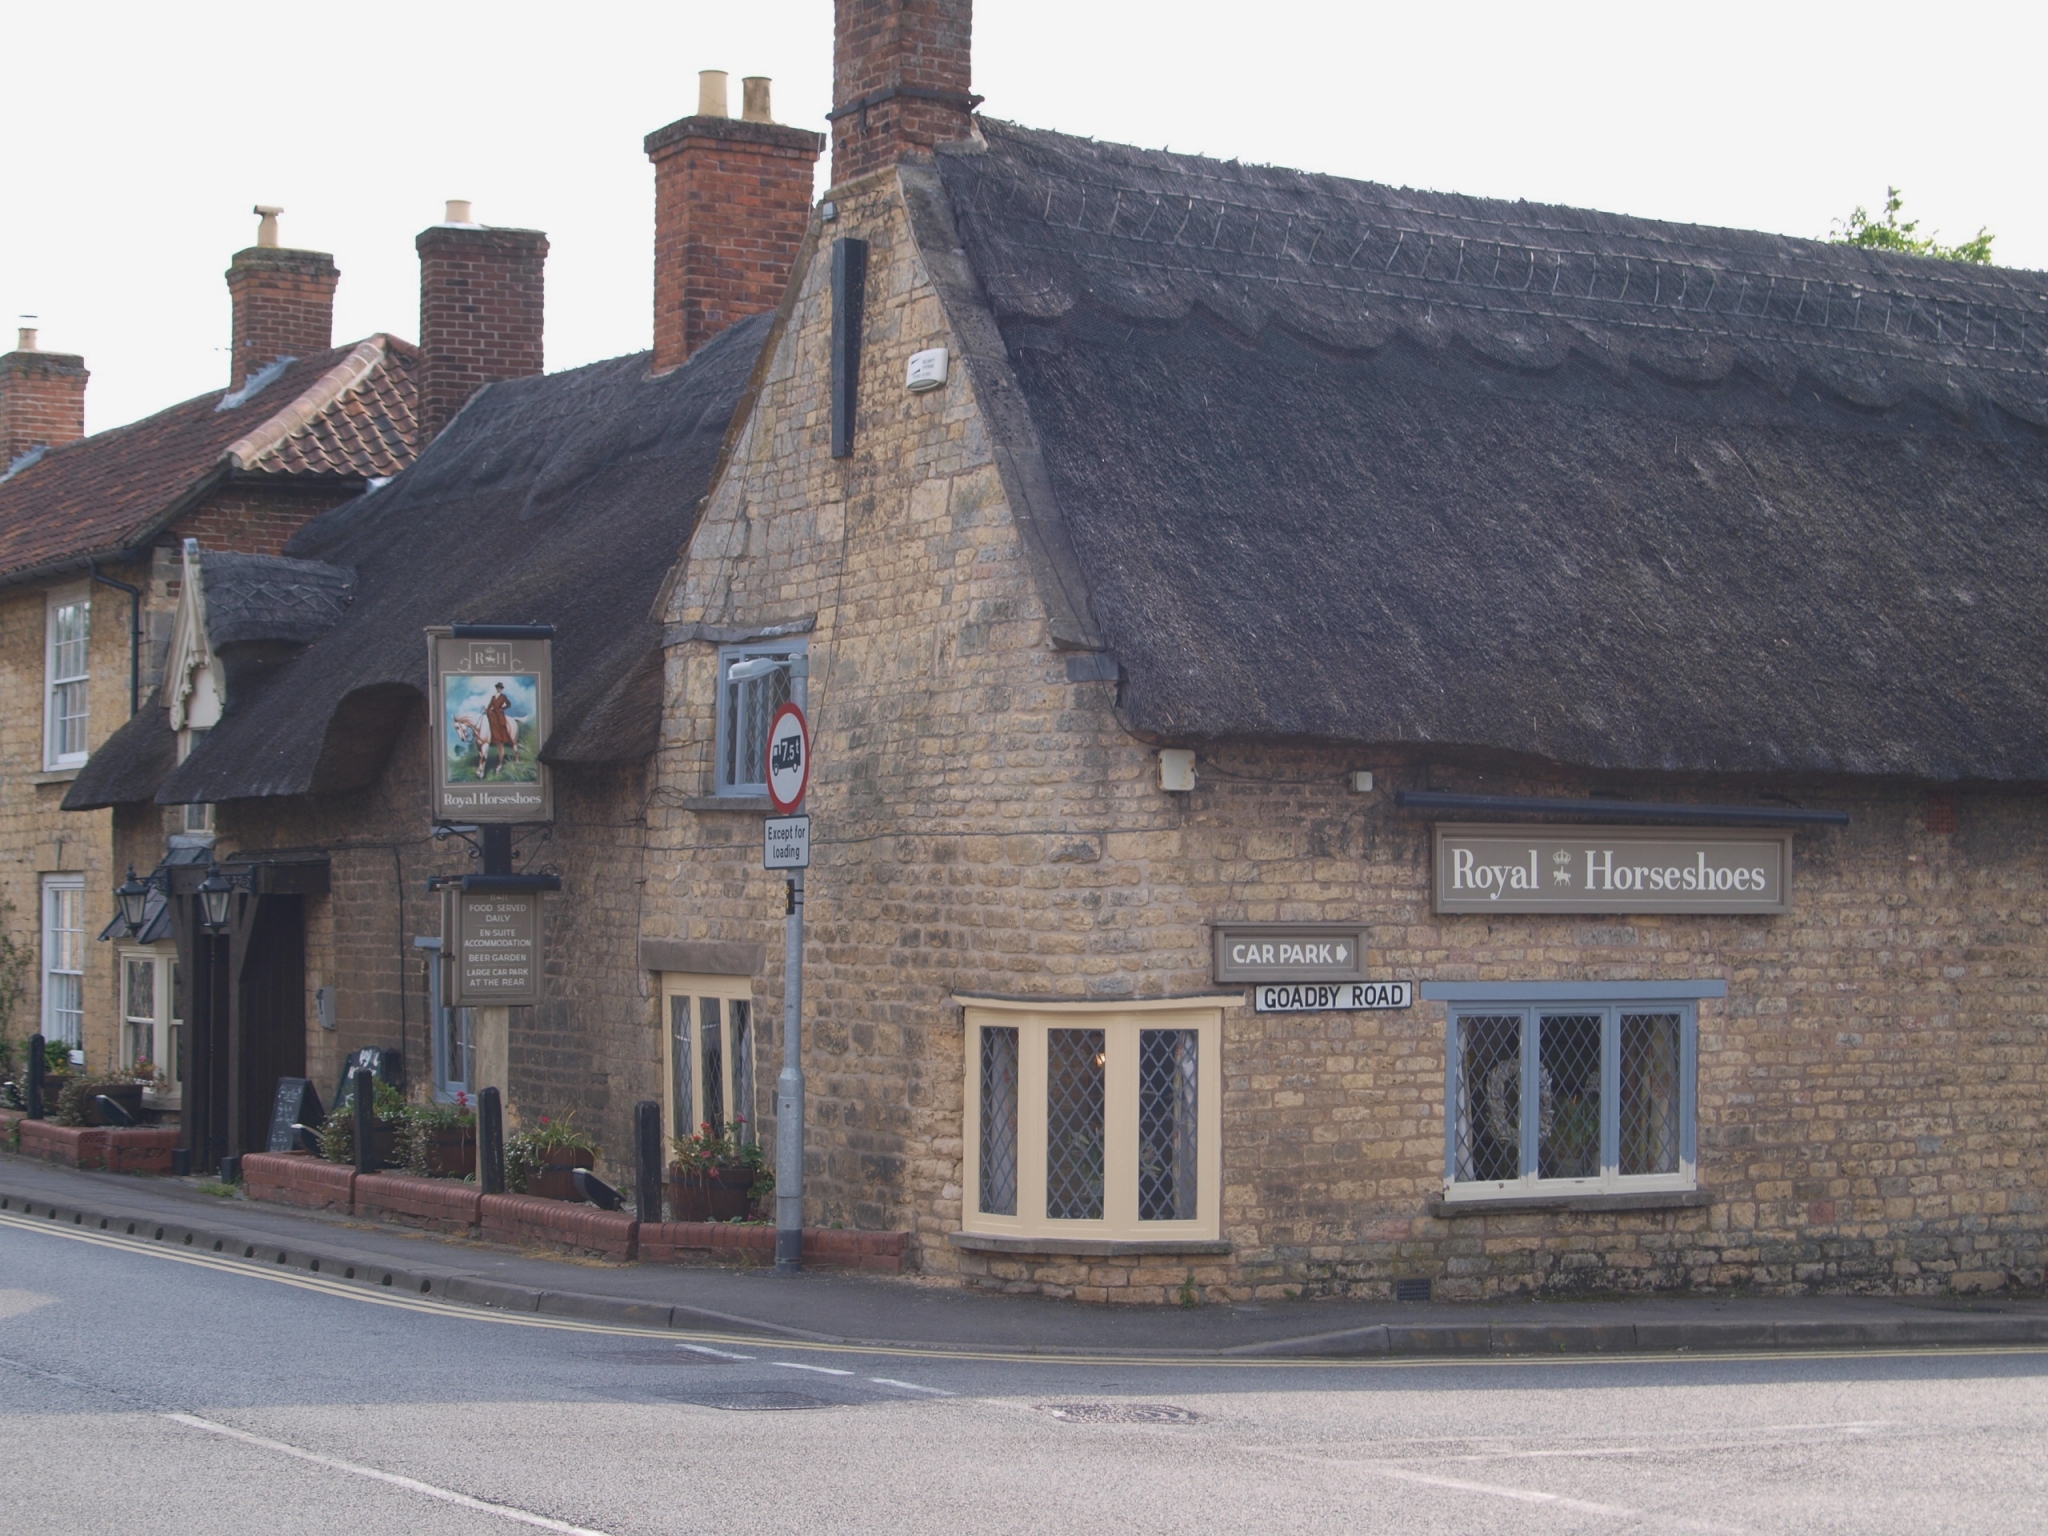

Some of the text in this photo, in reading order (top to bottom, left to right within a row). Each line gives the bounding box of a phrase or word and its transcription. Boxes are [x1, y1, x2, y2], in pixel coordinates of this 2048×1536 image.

[444, 792, 541, 808] Royal Horseshoes
[768, 825, 805, 841] Except for
[773, 844, 800, 859] loading
[1452, 849, 1766, 900] Royal Horseshoes
[469, 904, 526, 912] FOOD SERVED
[464, 939, 531, 947] ACCOMMODATION
[469, 954, 490, 962] BEER
[1232, 944, 1333, 963] CAR PARK
[1265, 985, 1403, 1008] GOADBY ROAD
